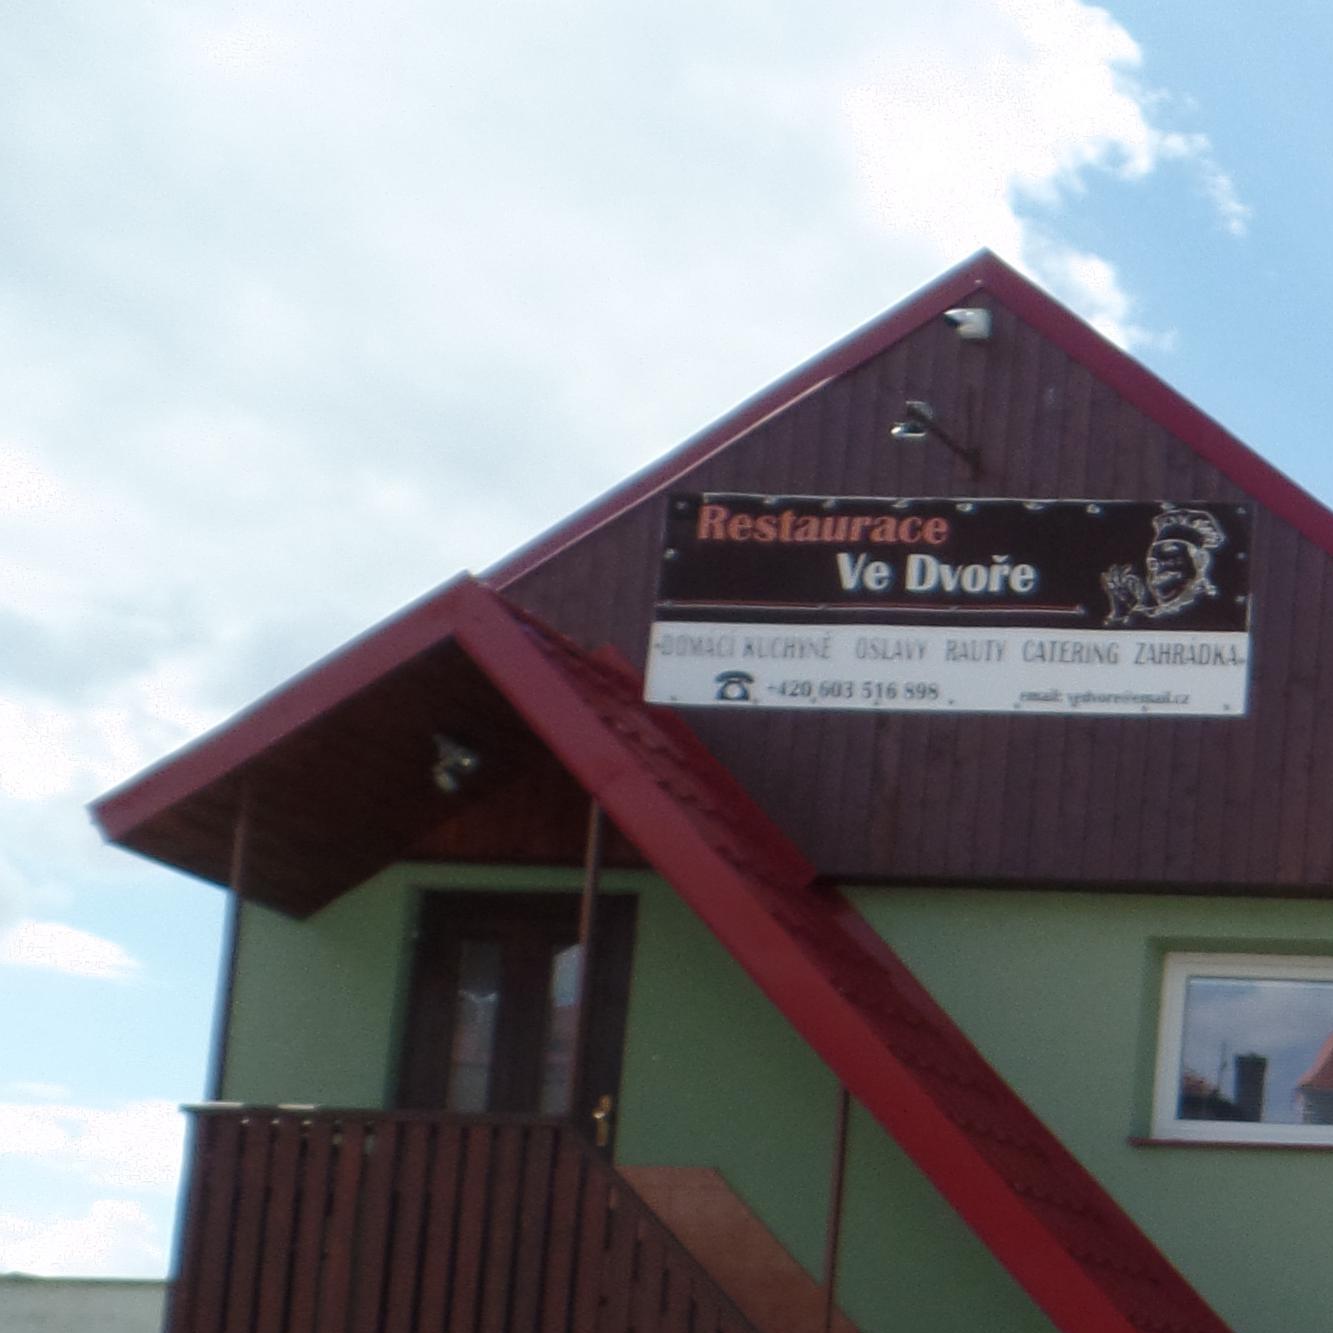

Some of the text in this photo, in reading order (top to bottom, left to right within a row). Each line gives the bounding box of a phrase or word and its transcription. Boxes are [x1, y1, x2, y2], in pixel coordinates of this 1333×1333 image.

[698, 504, 950, 545] Restaurace
[836, 551, 1037, 593] Ve Dvoře
[856, 637, 927, 661] OSLAVY
[945, 638, 1005, 662] RAUTY
[1022, 639, 1119, 665] CATERING
[861, 682, 898, 699] 516
